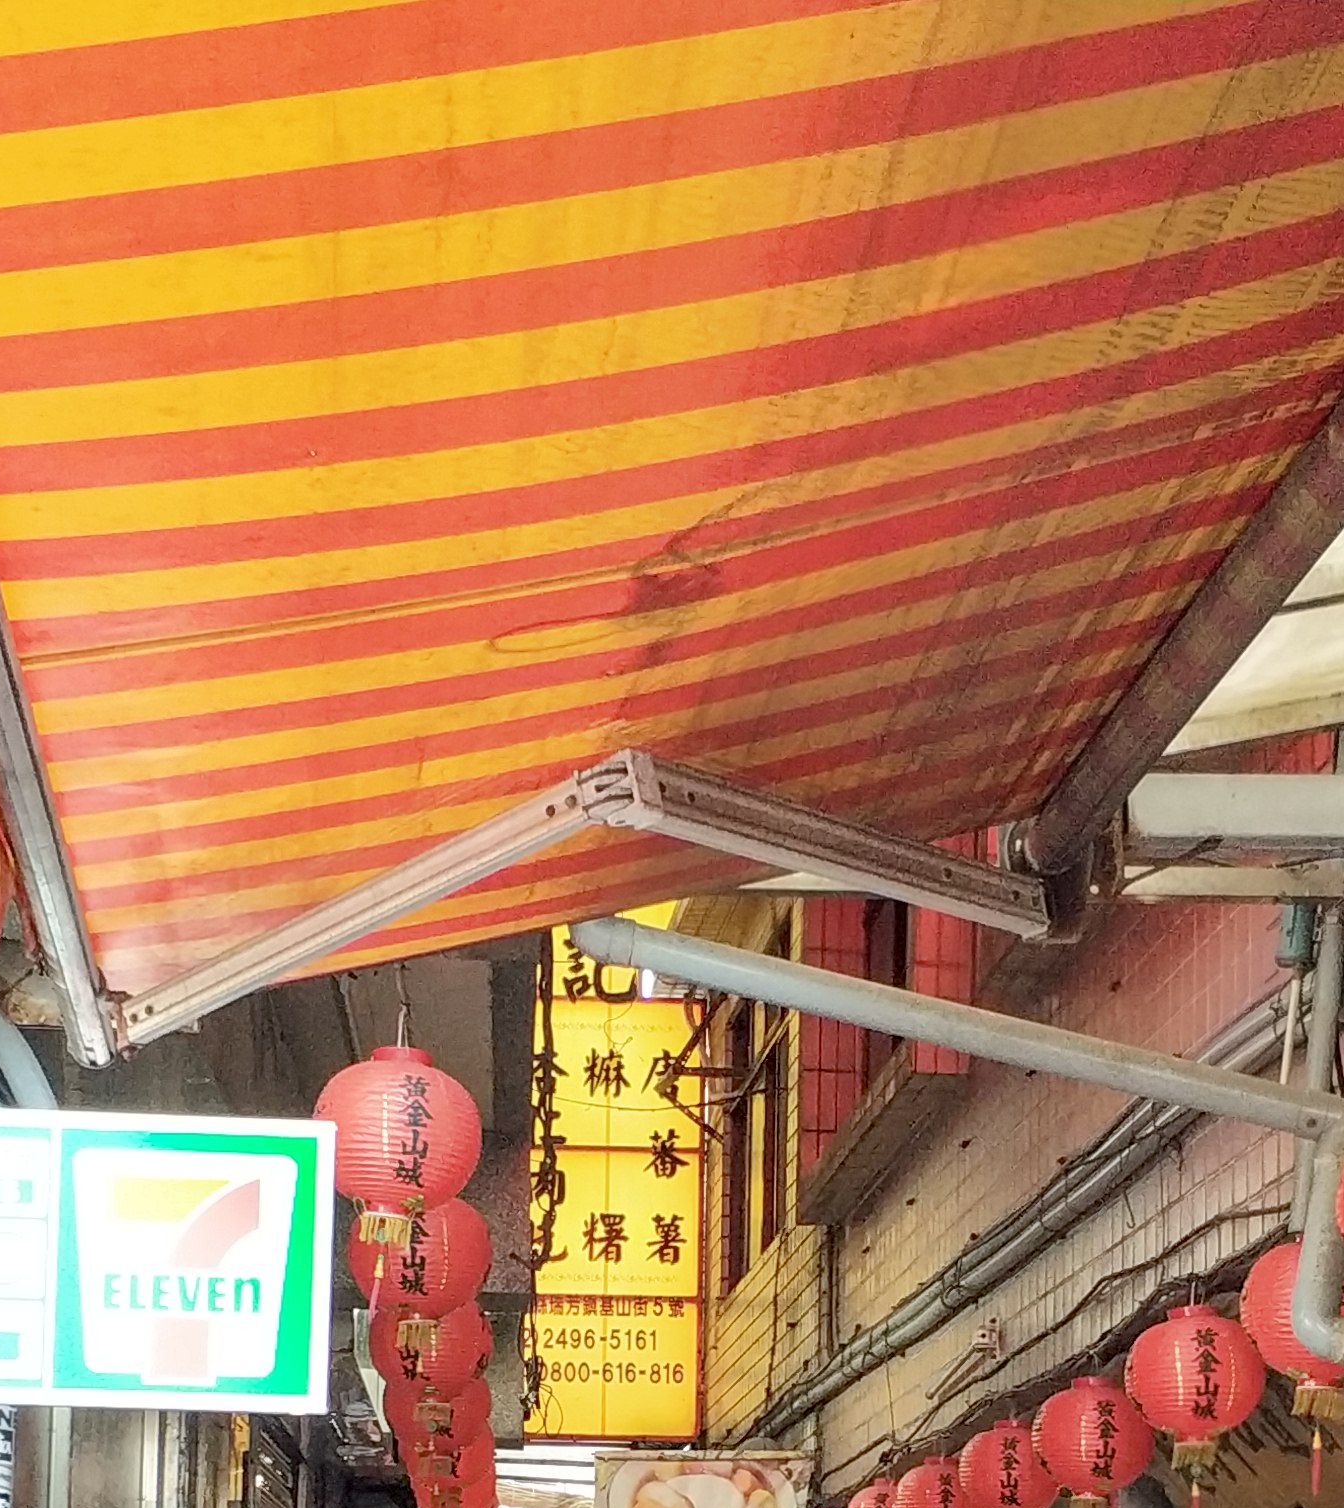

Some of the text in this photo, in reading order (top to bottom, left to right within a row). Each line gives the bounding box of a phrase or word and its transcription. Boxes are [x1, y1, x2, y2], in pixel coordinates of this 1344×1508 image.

[393, 1075, 434, 1188] 黃金山城
[539, 1361, 684, 1384] 0800-616-816
[543, 1328, 658, 1350] 2496-5161
[1191, 1326, 1220, 1420] 黃金山城
[999, 1435, 1022, 1507] 黃金山城
[1091, 1400, 1119, 1480] 黃金山城
